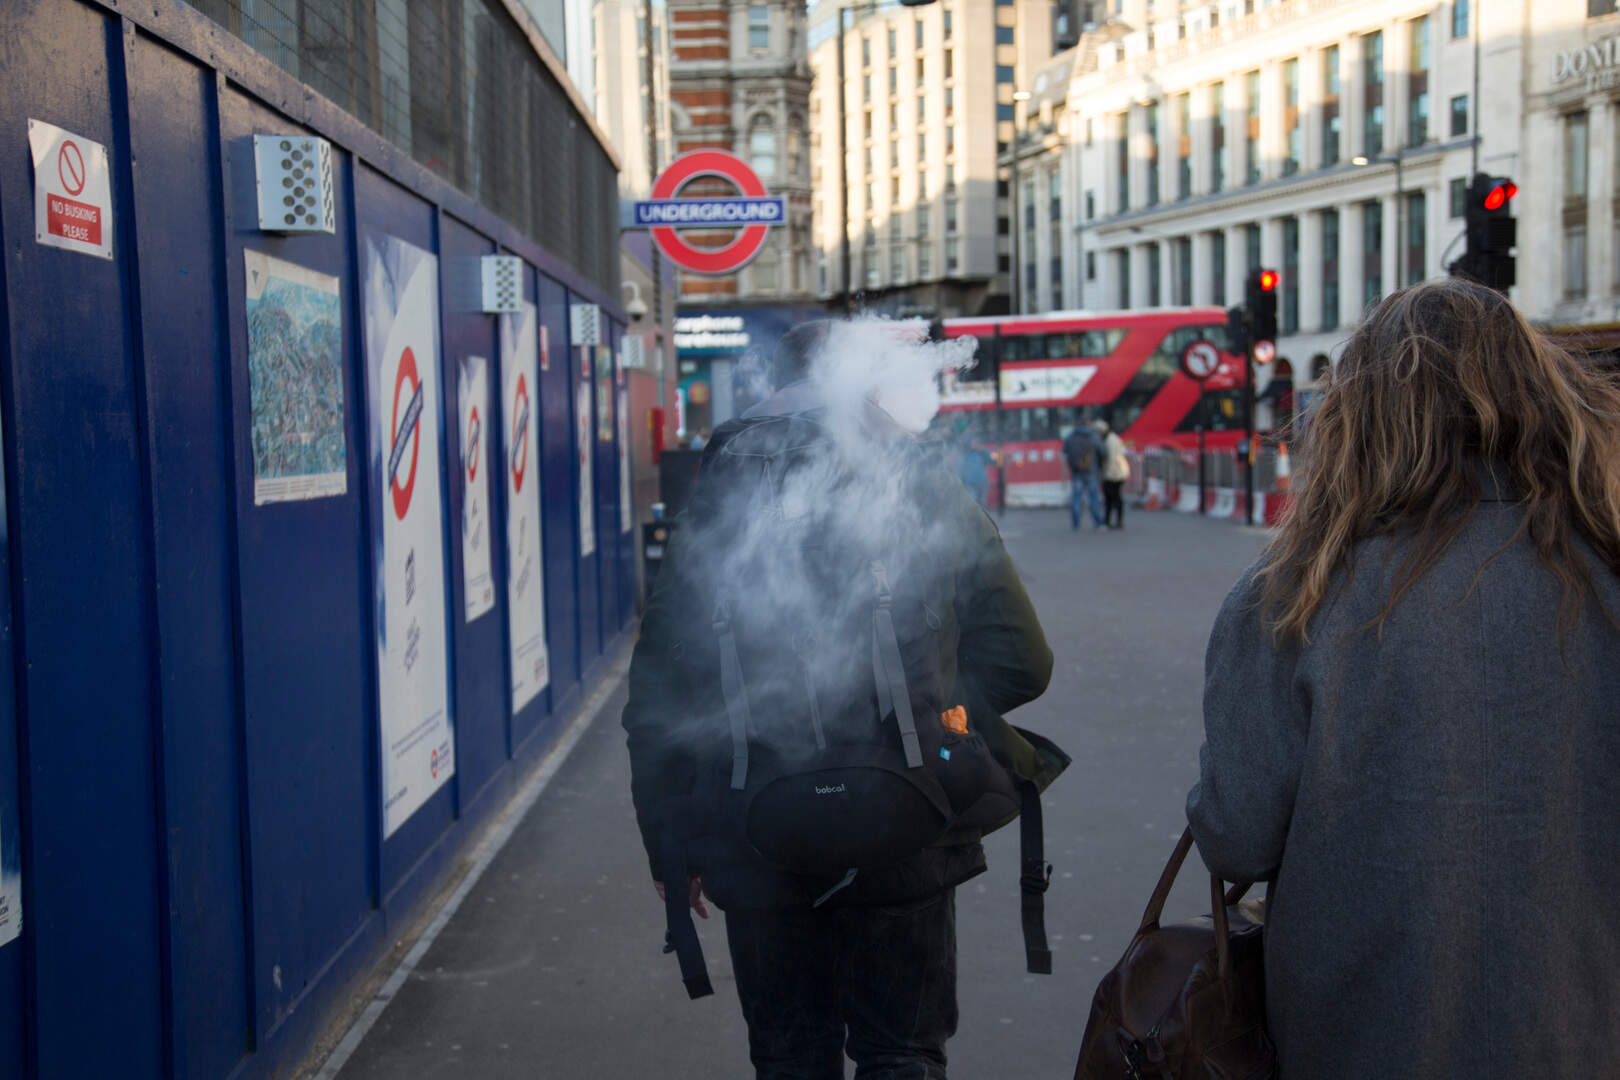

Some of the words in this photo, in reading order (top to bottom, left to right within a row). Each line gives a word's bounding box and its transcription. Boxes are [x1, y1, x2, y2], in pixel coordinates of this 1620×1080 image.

[52, 200, 63, 214] NO
[65, 203, 97, 222] BUSKING
[640, 203, 778, 221] UNDERGROUND
[63, 224, 89, 240] PLEASE
